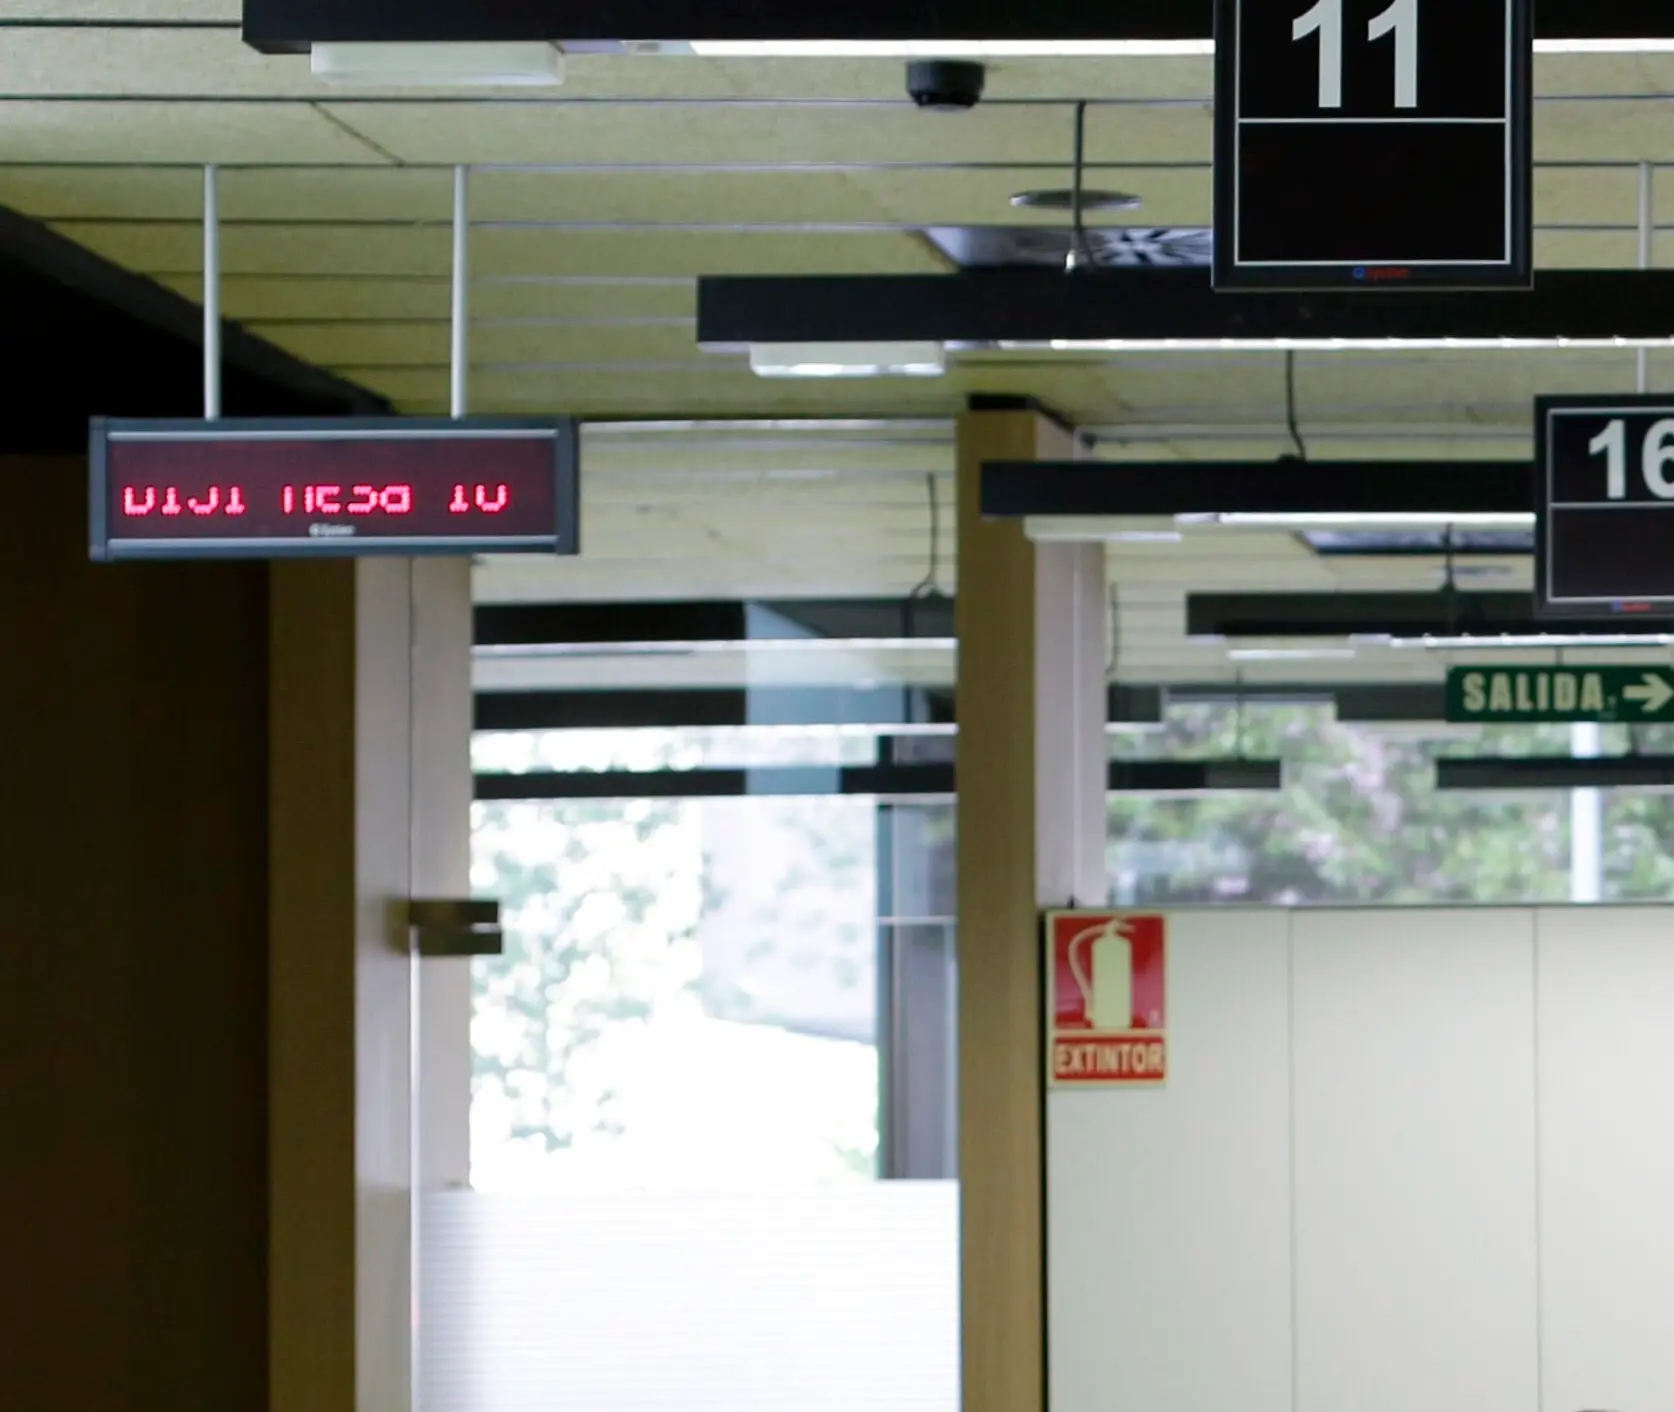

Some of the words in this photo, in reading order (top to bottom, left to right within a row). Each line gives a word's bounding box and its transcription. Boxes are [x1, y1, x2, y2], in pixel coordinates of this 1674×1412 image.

[1292, 0, 1418, 108] 11
[1461, 671, 1605, 712] SALIDA
[1055, 1043, 1163, 1074] EXTINTOR
